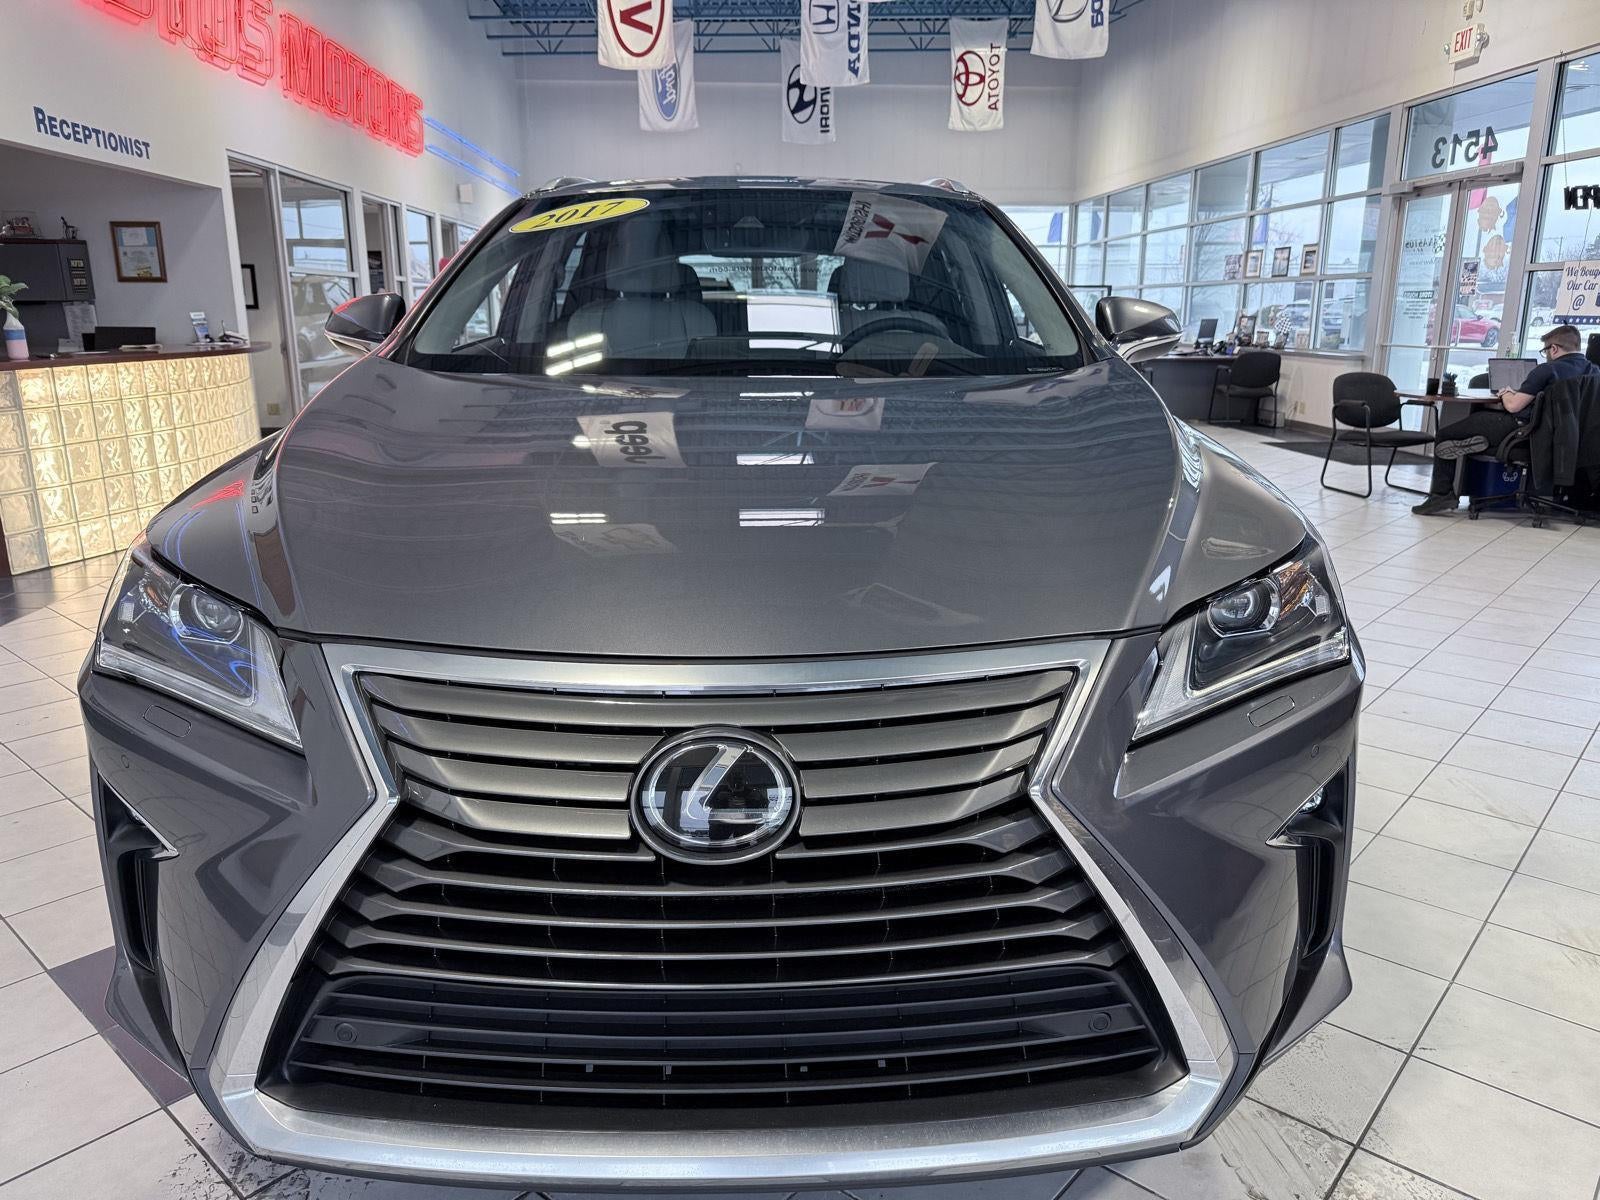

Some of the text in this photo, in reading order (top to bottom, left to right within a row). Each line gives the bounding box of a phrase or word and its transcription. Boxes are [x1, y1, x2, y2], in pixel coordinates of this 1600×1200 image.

[1453, 27, 1474, 53] EXIT
[279, 11, 425, 157] MOTORS
[33, 105, 151, 161] RECEPTIONIST
[530, 200, 626, 229] 2017
[1566, 280, 1598, 291] Our Car
